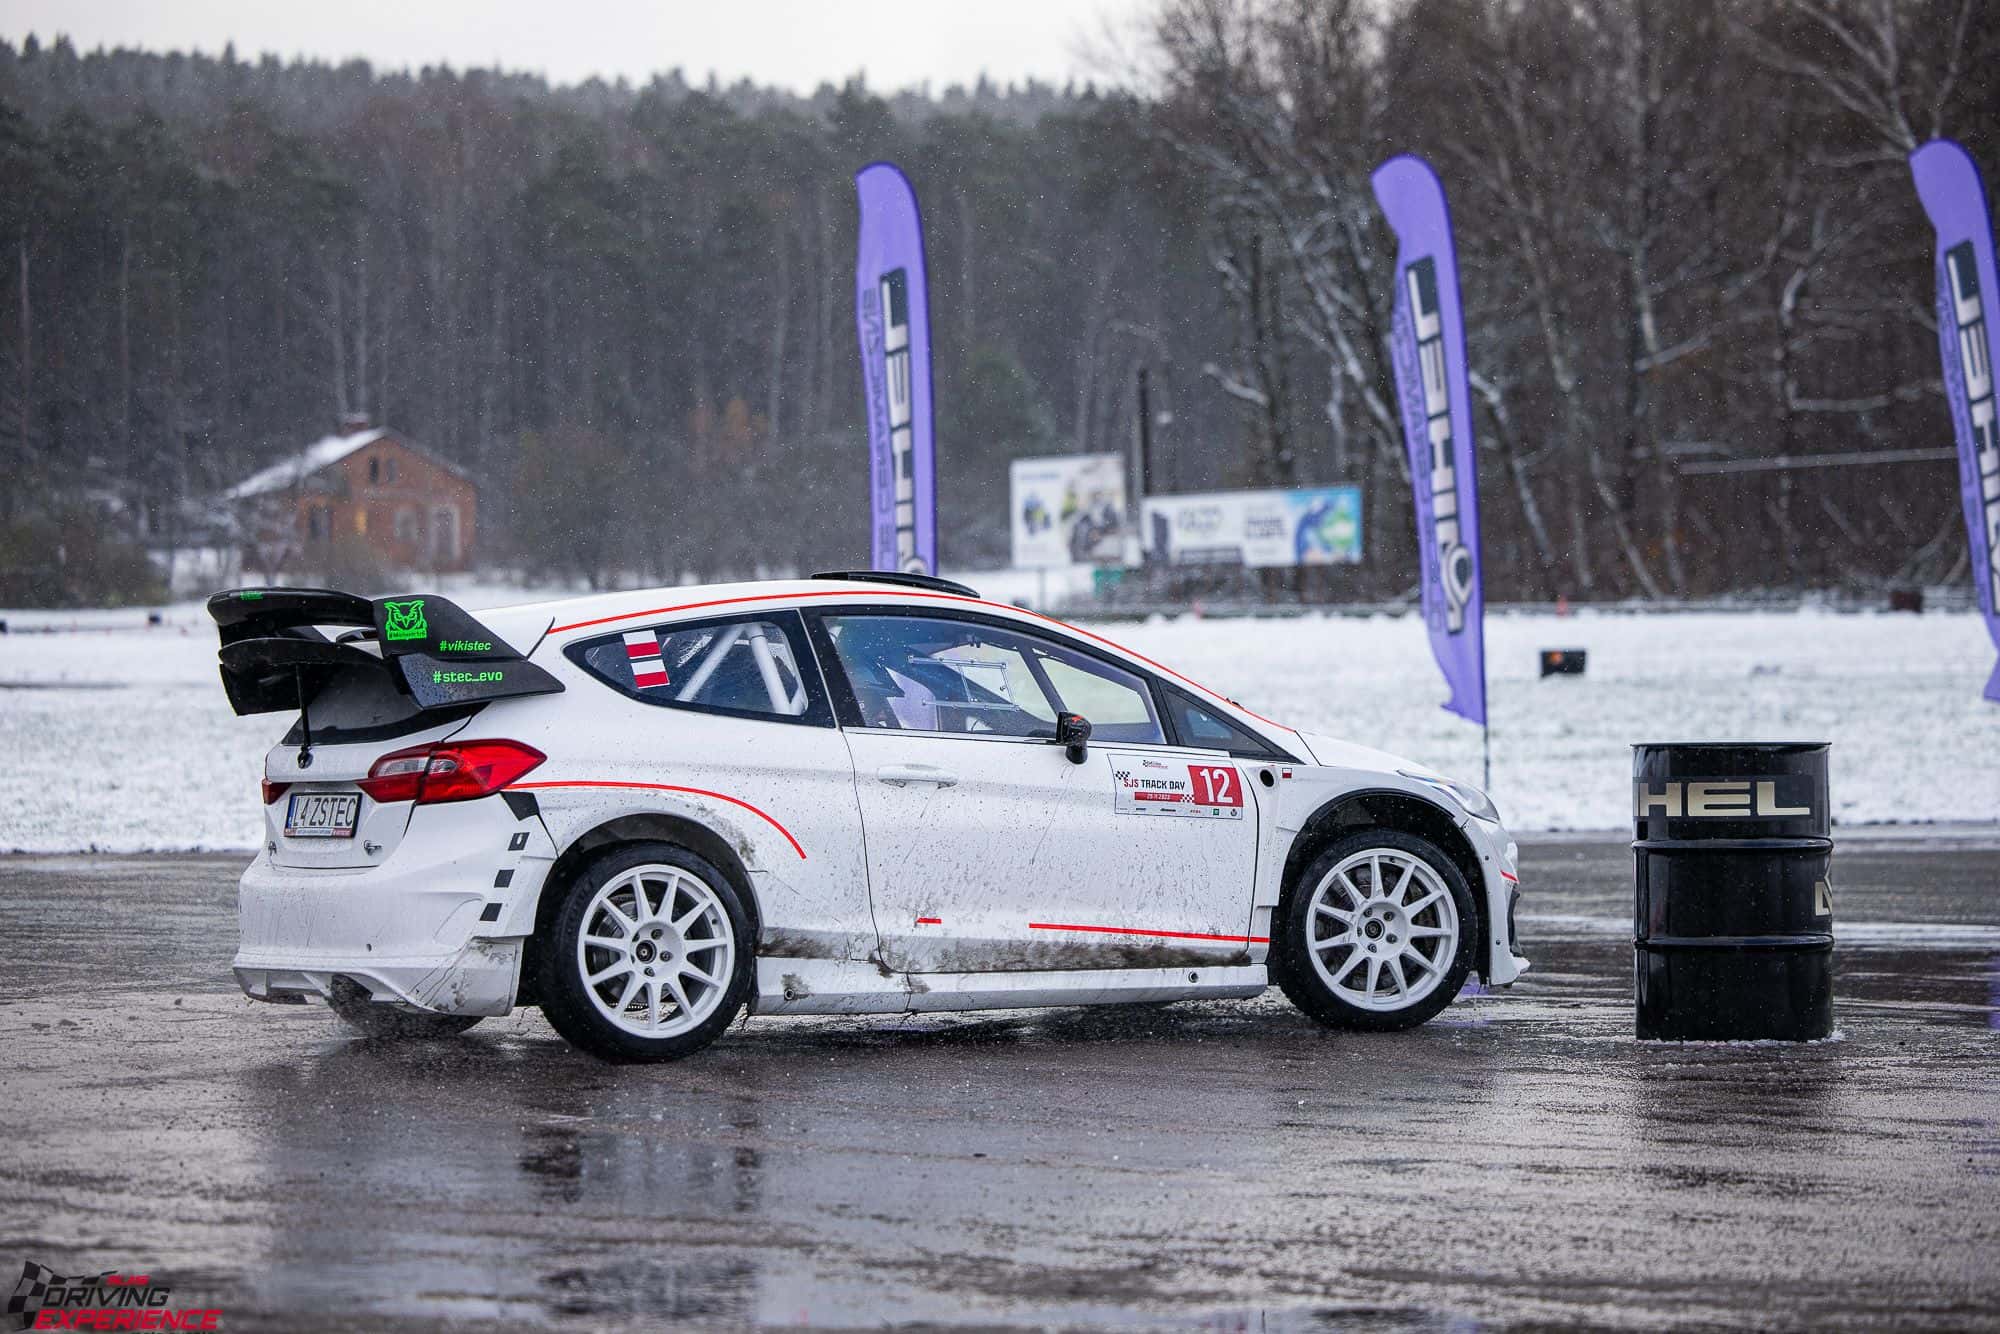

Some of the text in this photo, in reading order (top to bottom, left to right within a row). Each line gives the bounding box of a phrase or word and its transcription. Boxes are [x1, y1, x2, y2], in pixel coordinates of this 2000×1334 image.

[439, 640, 492, 652] #vikistec
[432, 670, 504, 684] #stec_evo
[1124, 777, 1186, 791] SJS TRACK DAY
[1200, 768, 1234, 804] 12
